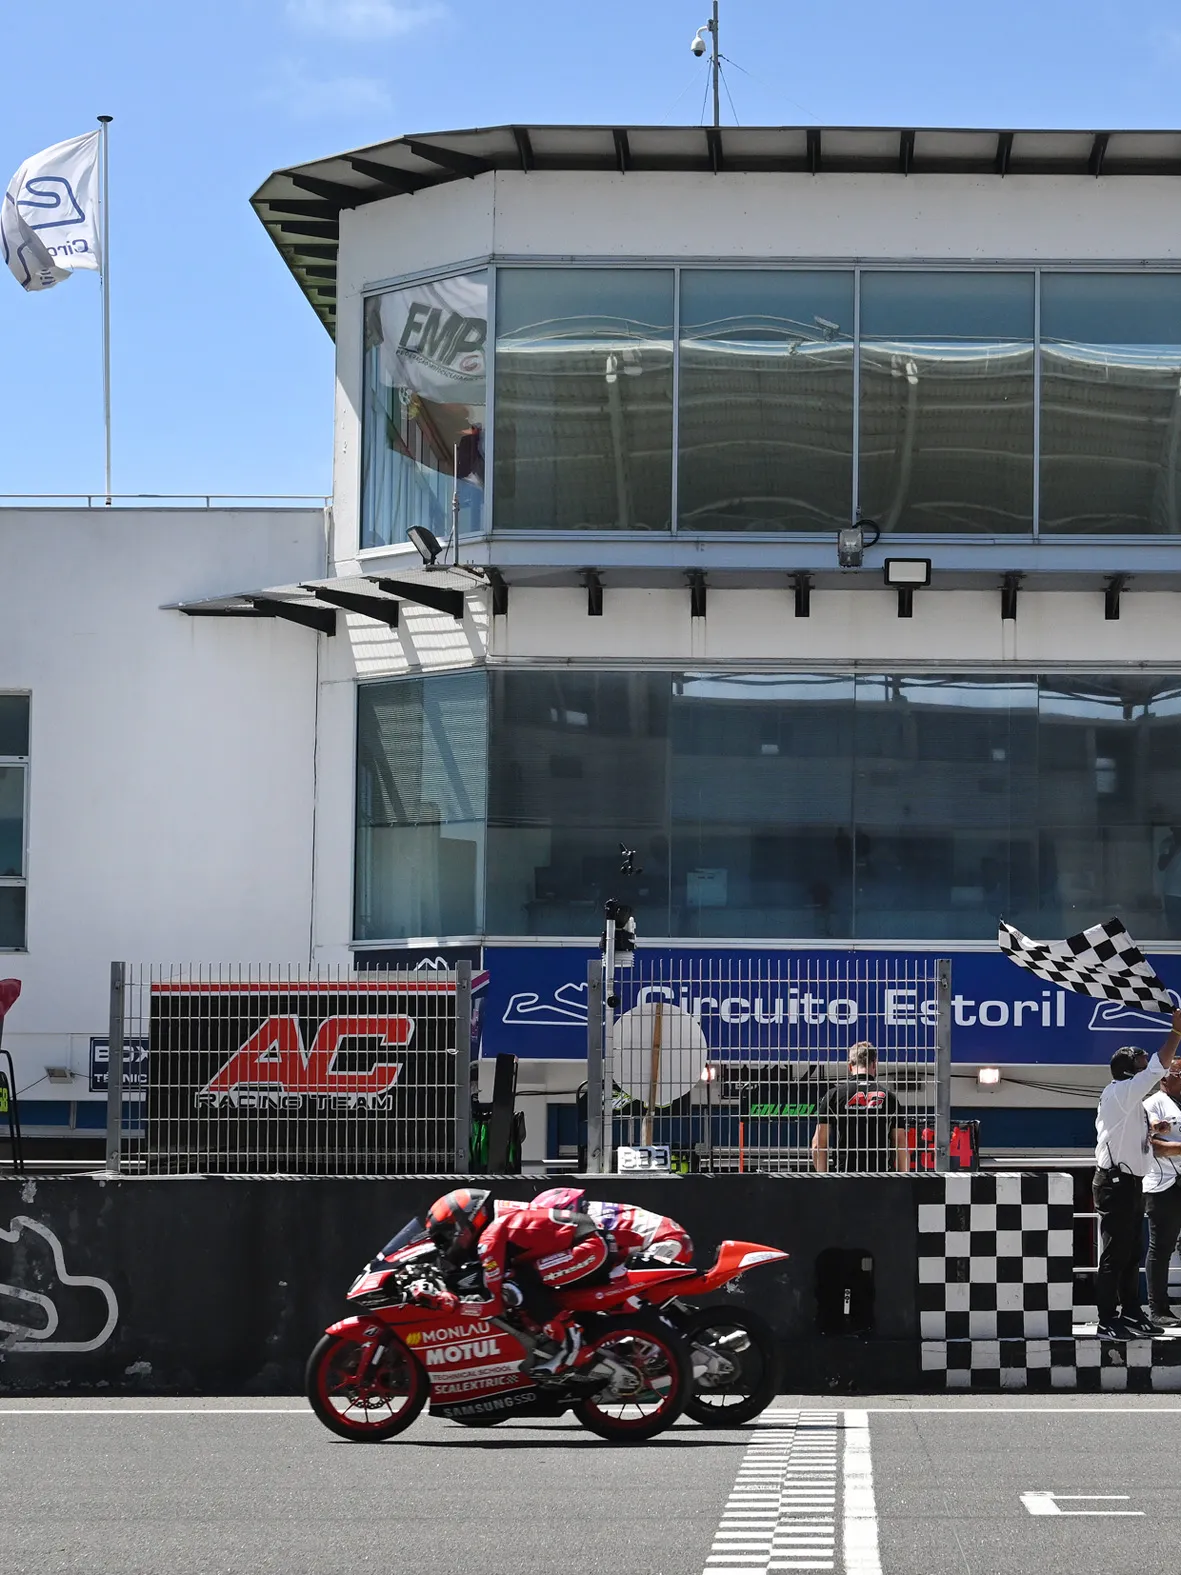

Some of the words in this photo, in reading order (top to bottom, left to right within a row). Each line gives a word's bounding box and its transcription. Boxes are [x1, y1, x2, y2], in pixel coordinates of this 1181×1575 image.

[884, 989, 1066, 1027] Estoril
[194, 1092, 304, 1110] RACING
[310, 1093, 393, 1111] TEAM
[422, 1321, 491, 1344] MONLAU
[426, 1339, 501, 1366] MOTUL
[434, 1376, 507, 1395] SCALEXTRIC
[443, 1397, 514, 1418] SAMSUNG
